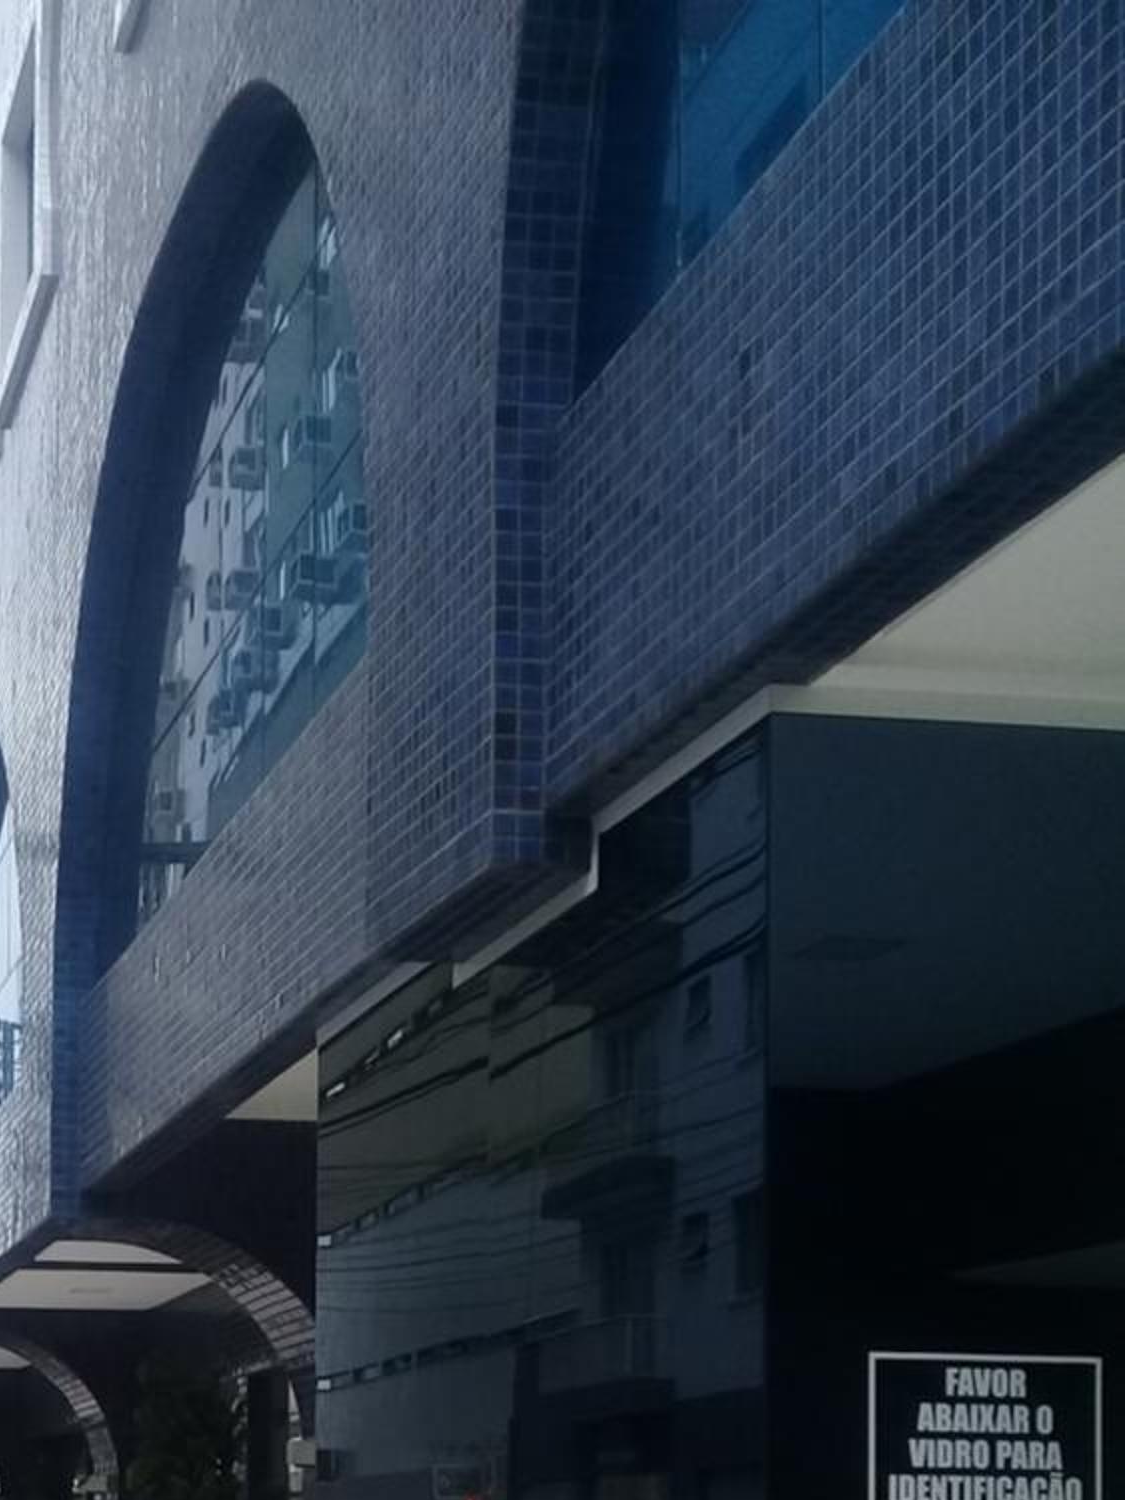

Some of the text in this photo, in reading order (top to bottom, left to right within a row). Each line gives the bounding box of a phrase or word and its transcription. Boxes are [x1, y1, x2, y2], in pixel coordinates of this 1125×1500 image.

[945, 1367, 1027, 1398] FAVOR
[917, 1402, 1054, 1434] ABAIXAR O
[908, 1438, 1063, 1471] VIDRO PARA
